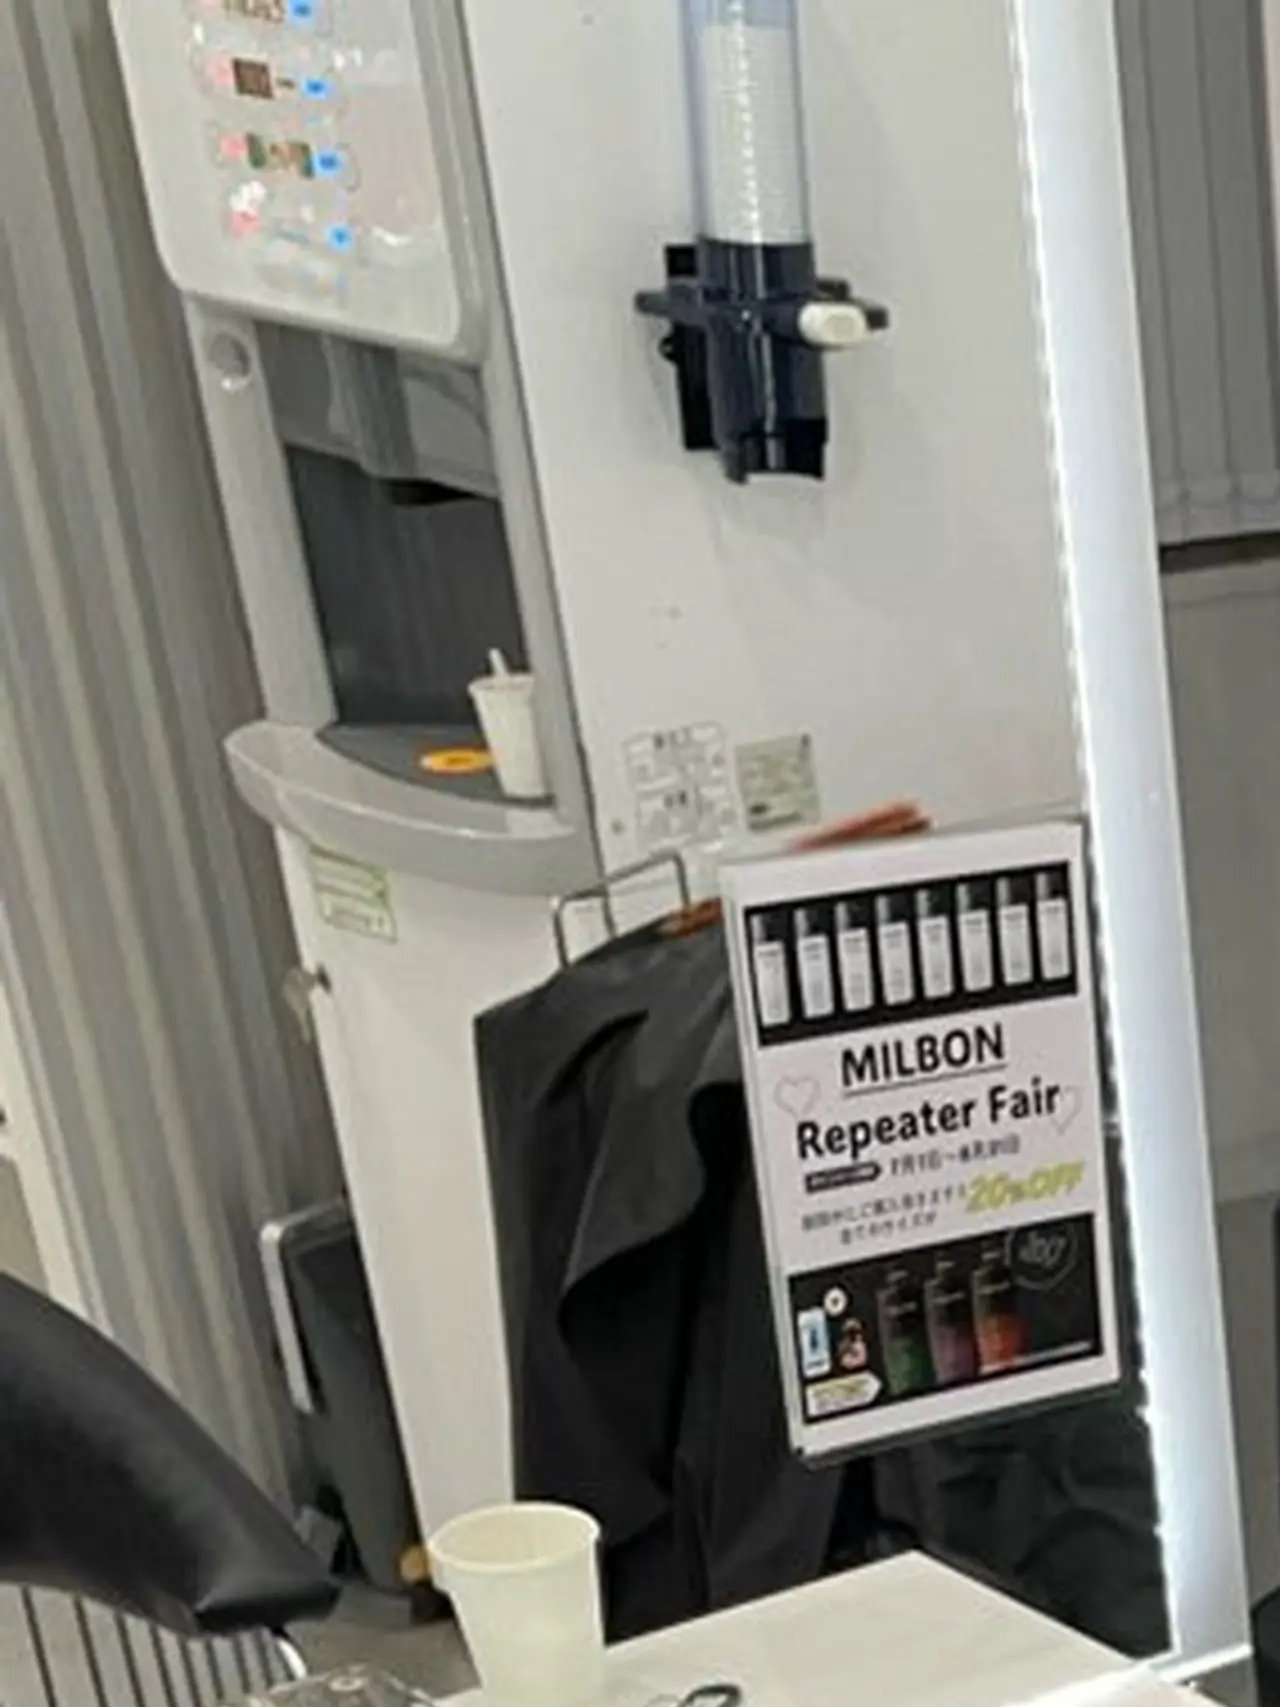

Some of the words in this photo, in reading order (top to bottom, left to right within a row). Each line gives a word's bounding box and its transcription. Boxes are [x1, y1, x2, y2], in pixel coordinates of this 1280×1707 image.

[840, 1021, 1005, 1088] MILBON
[796, 1100, 976, 1161] Repeater
[987, 1075, 1060, 1124] Fair
